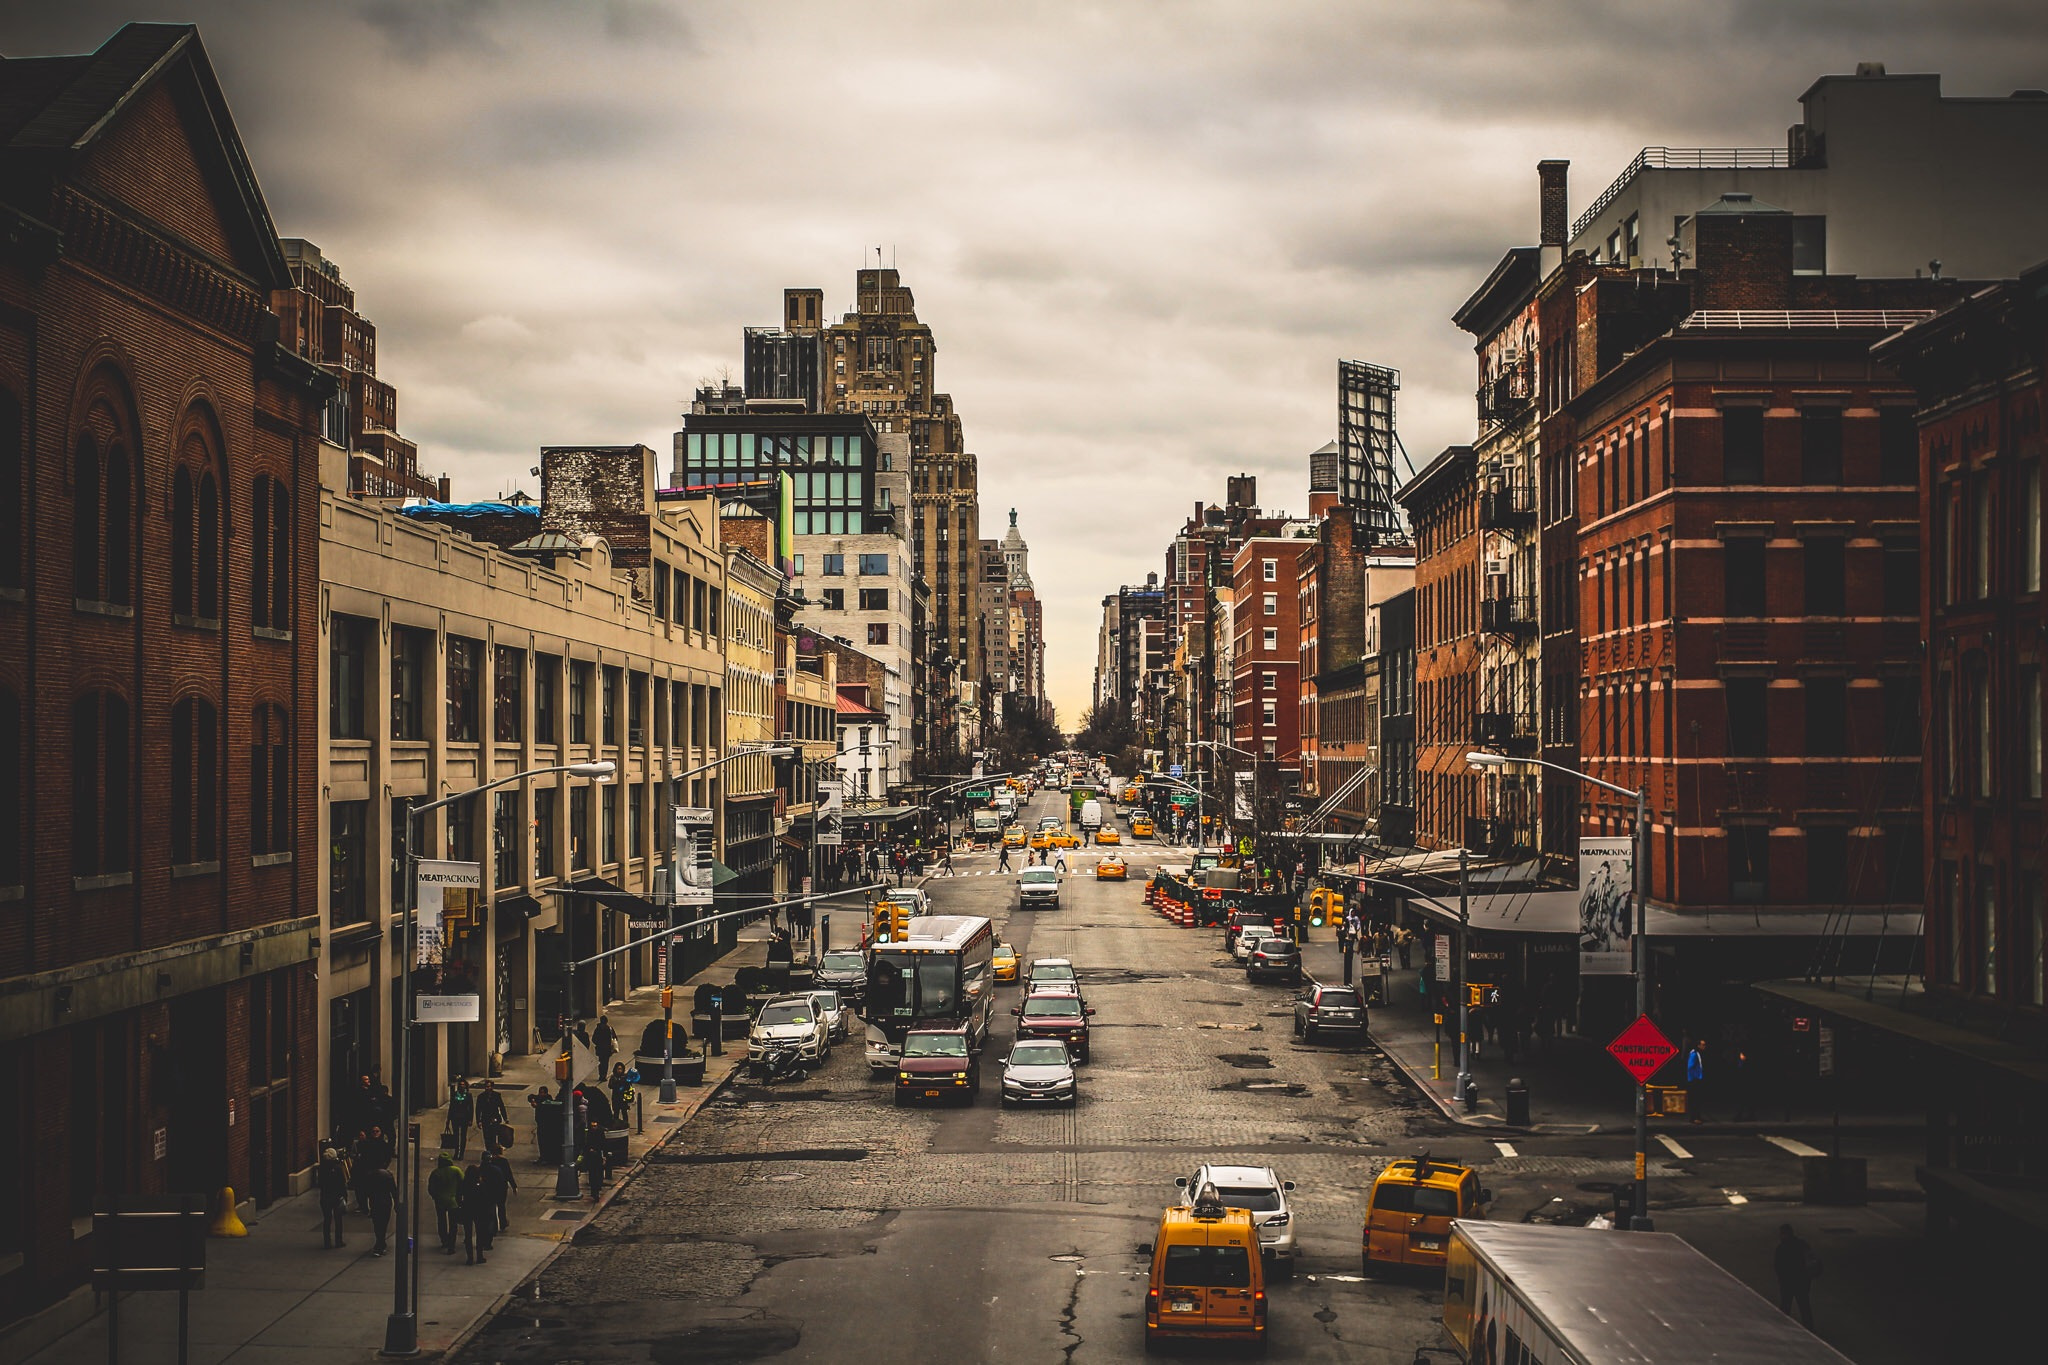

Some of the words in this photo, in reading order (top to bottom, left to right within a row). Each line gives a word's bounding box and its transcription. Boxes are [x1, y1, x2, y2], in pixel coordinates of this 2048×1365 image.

[419, 873, 480, 883] MEATPACKING
[1613, 1044, 1671, 1055] CONSTRUCTION
[1628, 1058, 1655, 1067] AHEAD
